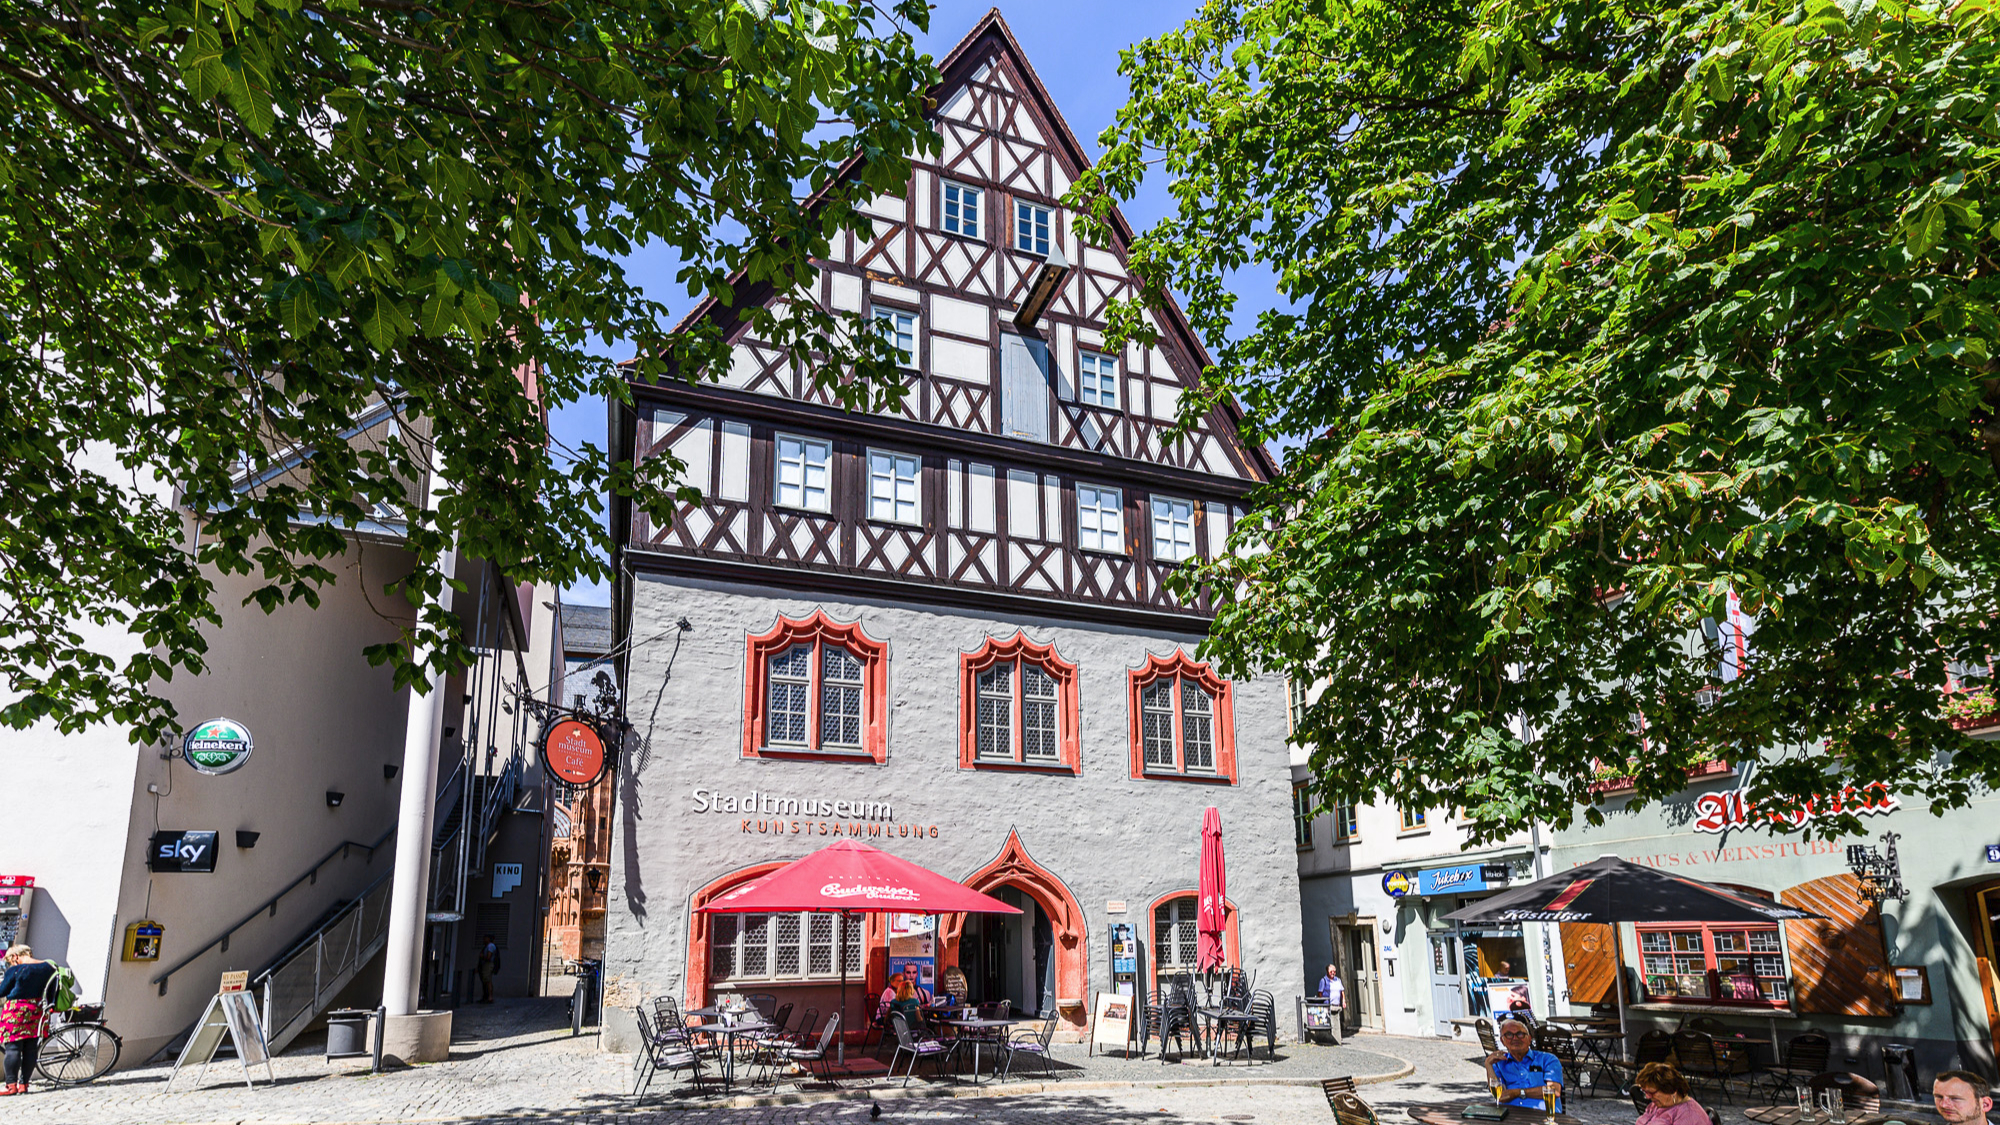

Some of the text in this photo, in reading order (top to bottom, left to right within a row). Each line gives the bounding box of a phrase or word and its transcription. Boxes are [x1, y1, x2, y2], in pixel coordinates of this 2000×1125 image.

[188, 740, 245, 751] Heineken
[565, 735, 587, 748] Stadt
[558, 742, 593, 756] museum
[565, 755, 584, 768] Café
[691, 788, 894, 820] Stadtmuseum
[741, 818, 940, 838] KUNSTSAMMLUNG
[159, 839, 207, 863] sky
[1685, 850, 1699, 865] &
[1702, 838, 1843, 863] WEINSTUBE
[496, 865, 520, 875] KINO
[820, 882, 920, 897] Budweiser
